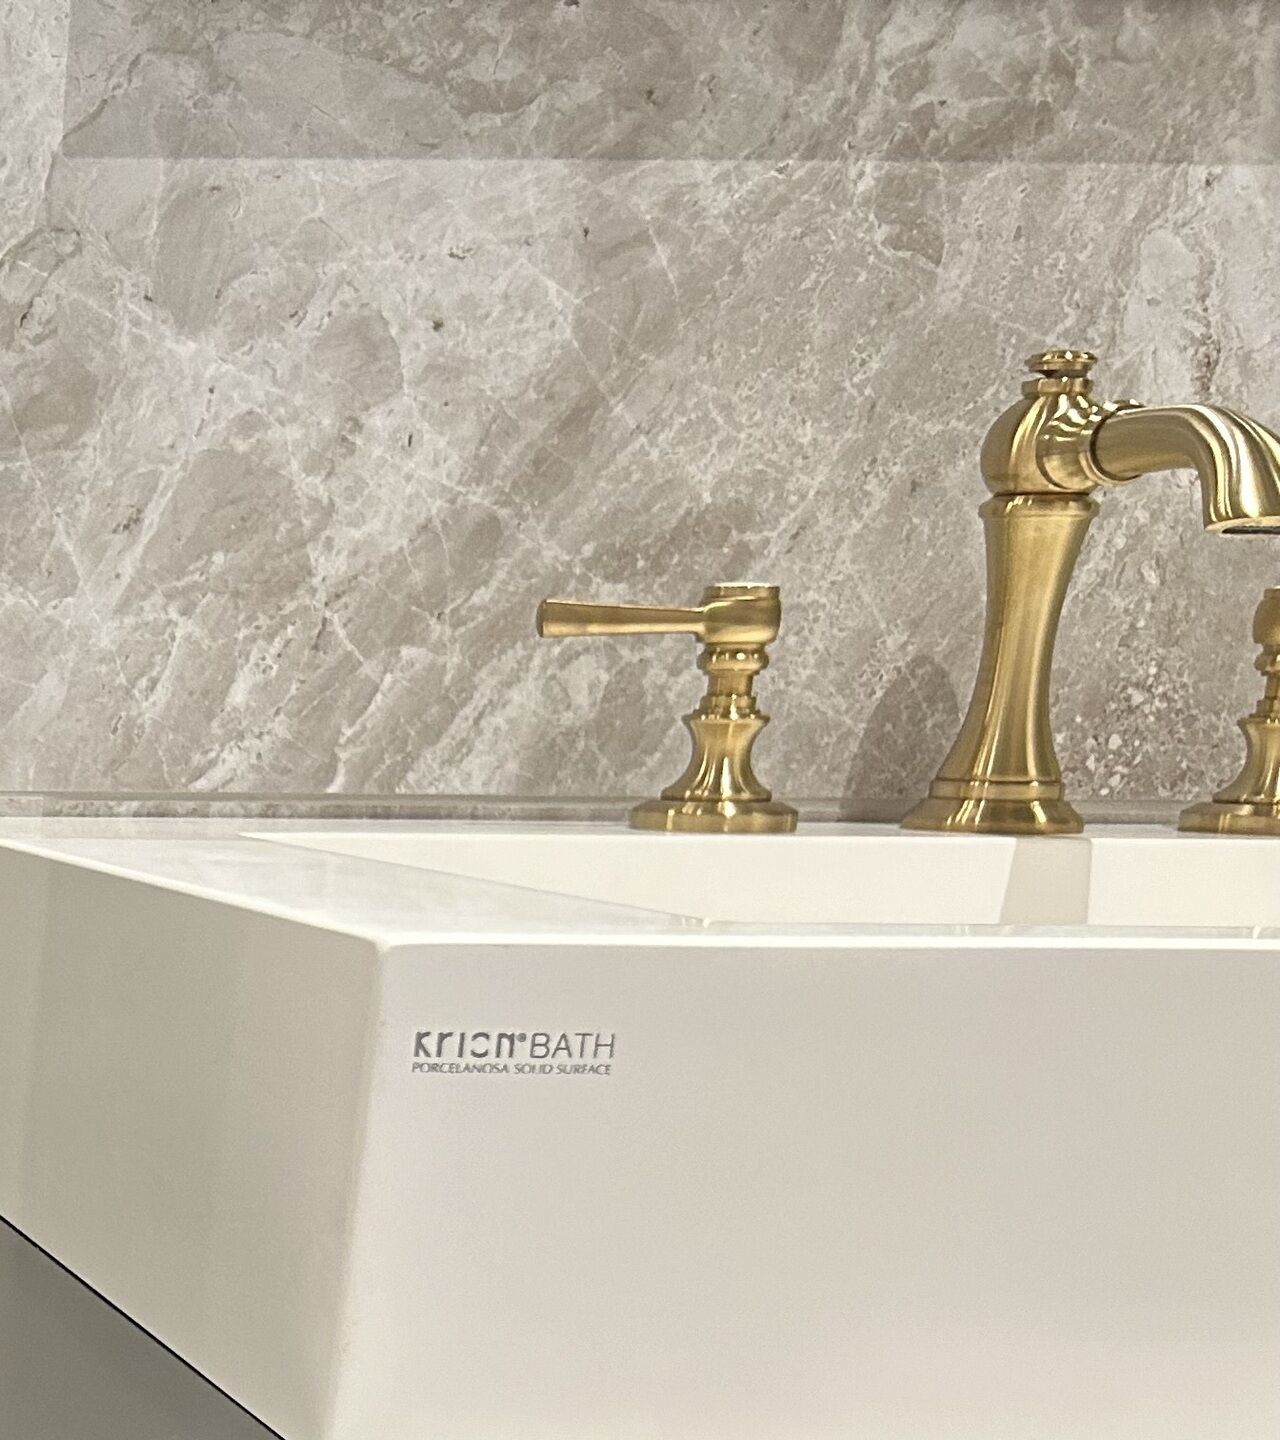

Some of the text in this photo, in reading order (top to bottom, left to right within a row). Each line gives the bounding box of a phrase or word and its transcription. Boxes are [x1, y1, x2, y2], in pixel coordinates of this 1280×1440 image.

[411, 1062, 611, 1075] PORCELANOSA SOLID SURFACE
